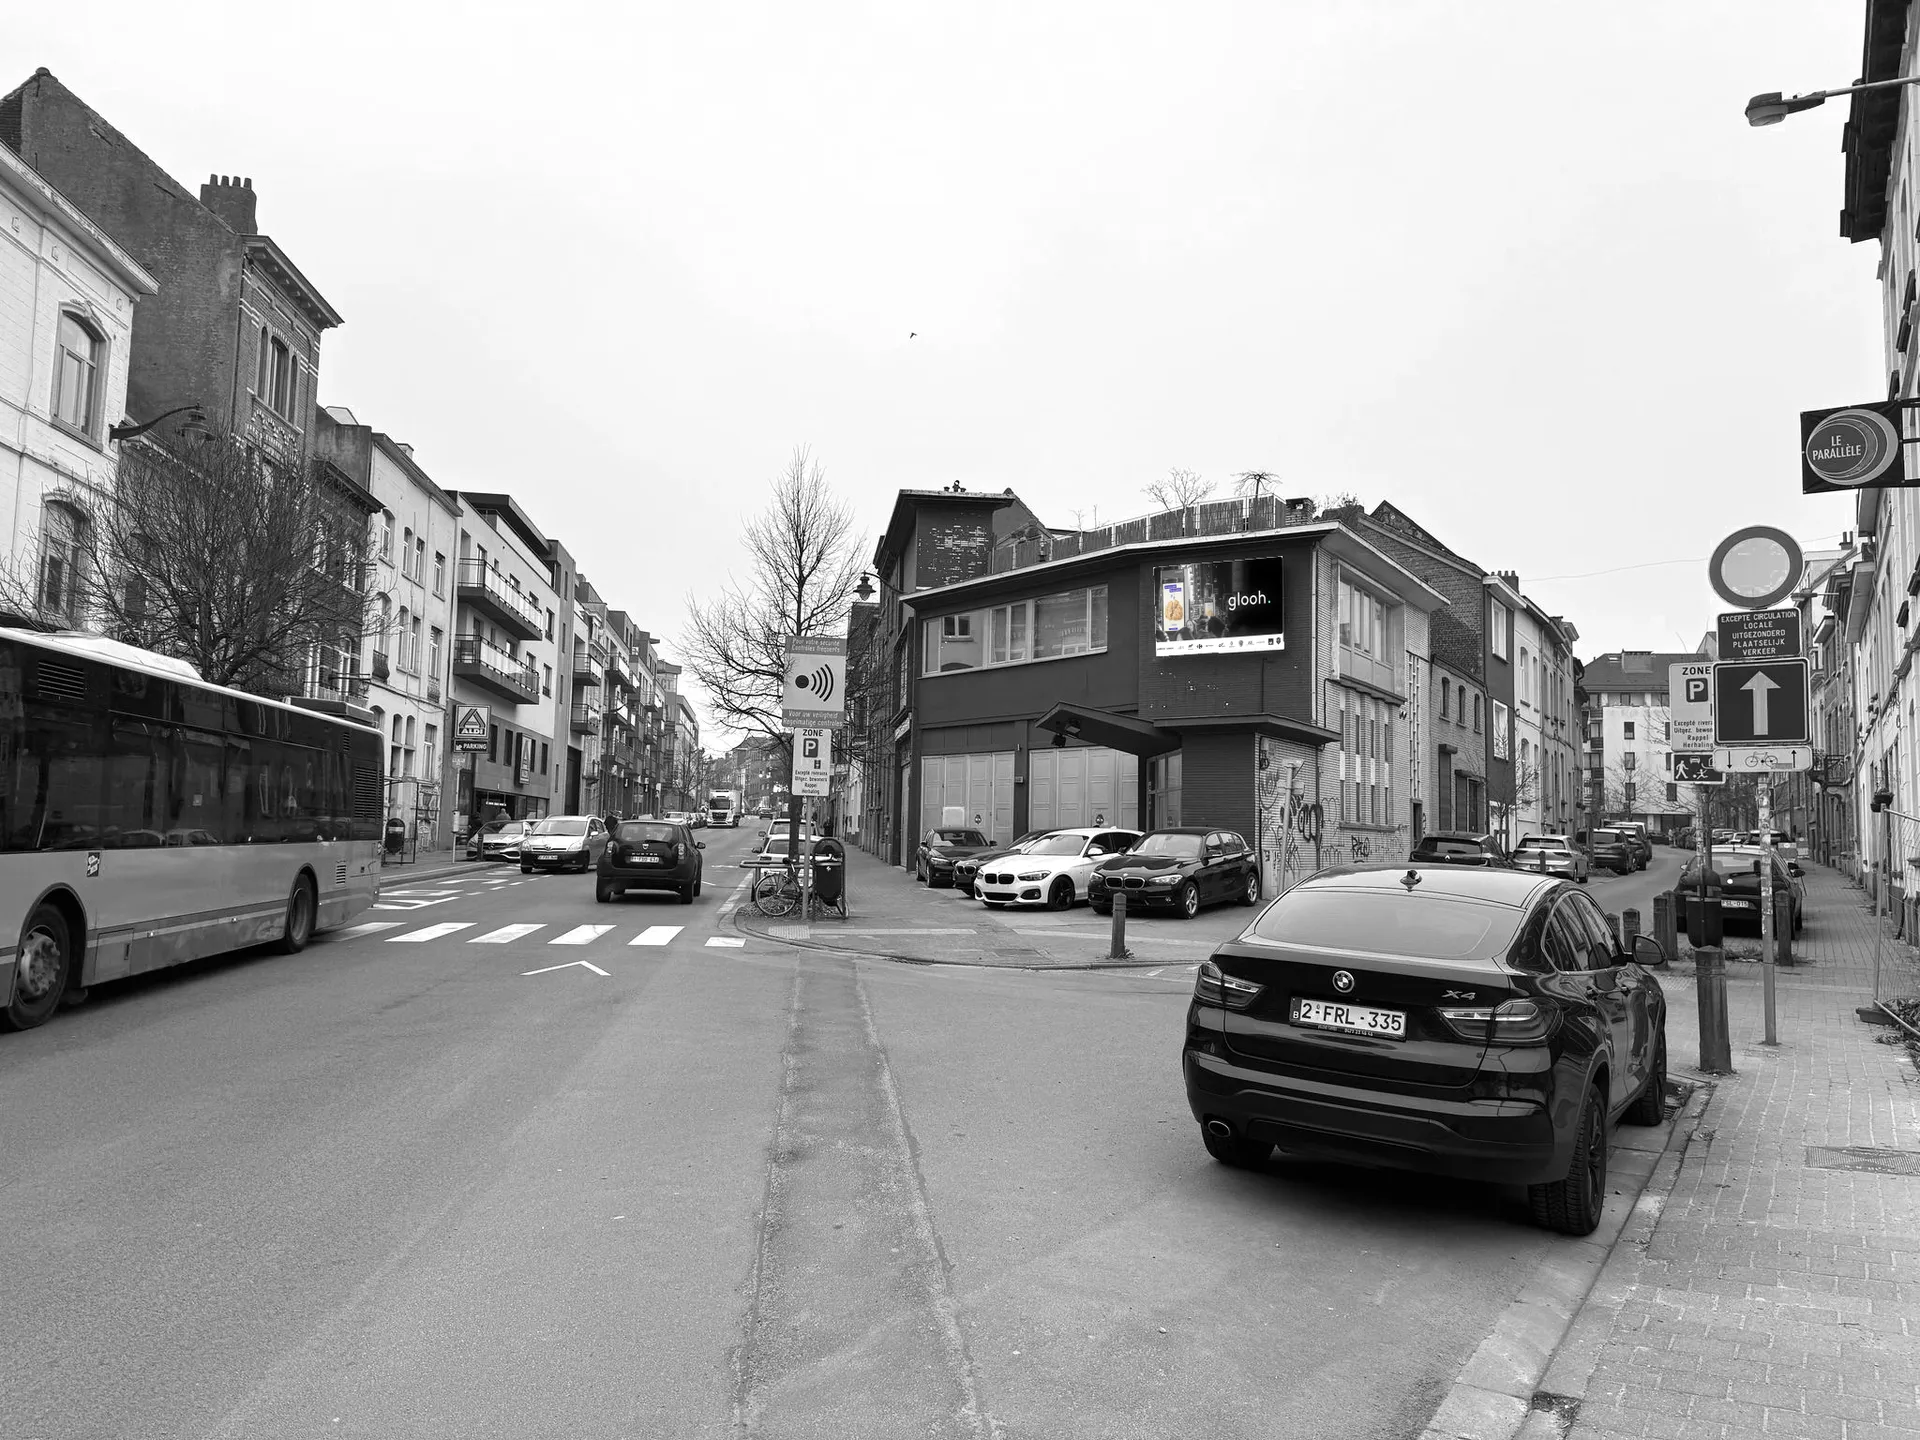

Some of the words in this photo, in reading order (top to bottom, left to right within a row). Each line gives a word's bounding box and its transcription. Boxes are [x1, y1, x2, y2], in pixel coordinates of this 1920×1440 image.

[1831, 435, 1842, 446] LE
[1812, 443, 1861, 461] PARALLÈLE
[1753, 611, 1797, 621] CIRCULATION
[1743, 621, 1773, 630] LOCALE
[1731, 629, 1786, 639] UITGEZONDERD
[1732, 638, 1785, 648] PLAATSELIJK
[1742, 647, 1776, 656] VERKEER
[1682, 666, 1711, 675] ZONE
[1689, 681, 1704, 700] P
[802, 729, 824, 737] ZONE
[1687, 734, 1709, 742] Rappel
[805, 740, 817, 756] P
[1682, 741, 1714, 750] Herhaling
[1441, 990, 1476, 1000] X4
[1293, 1010, 1299, 1019] B
[1302, 1002, 1402, 1031] 2-FRL-335
